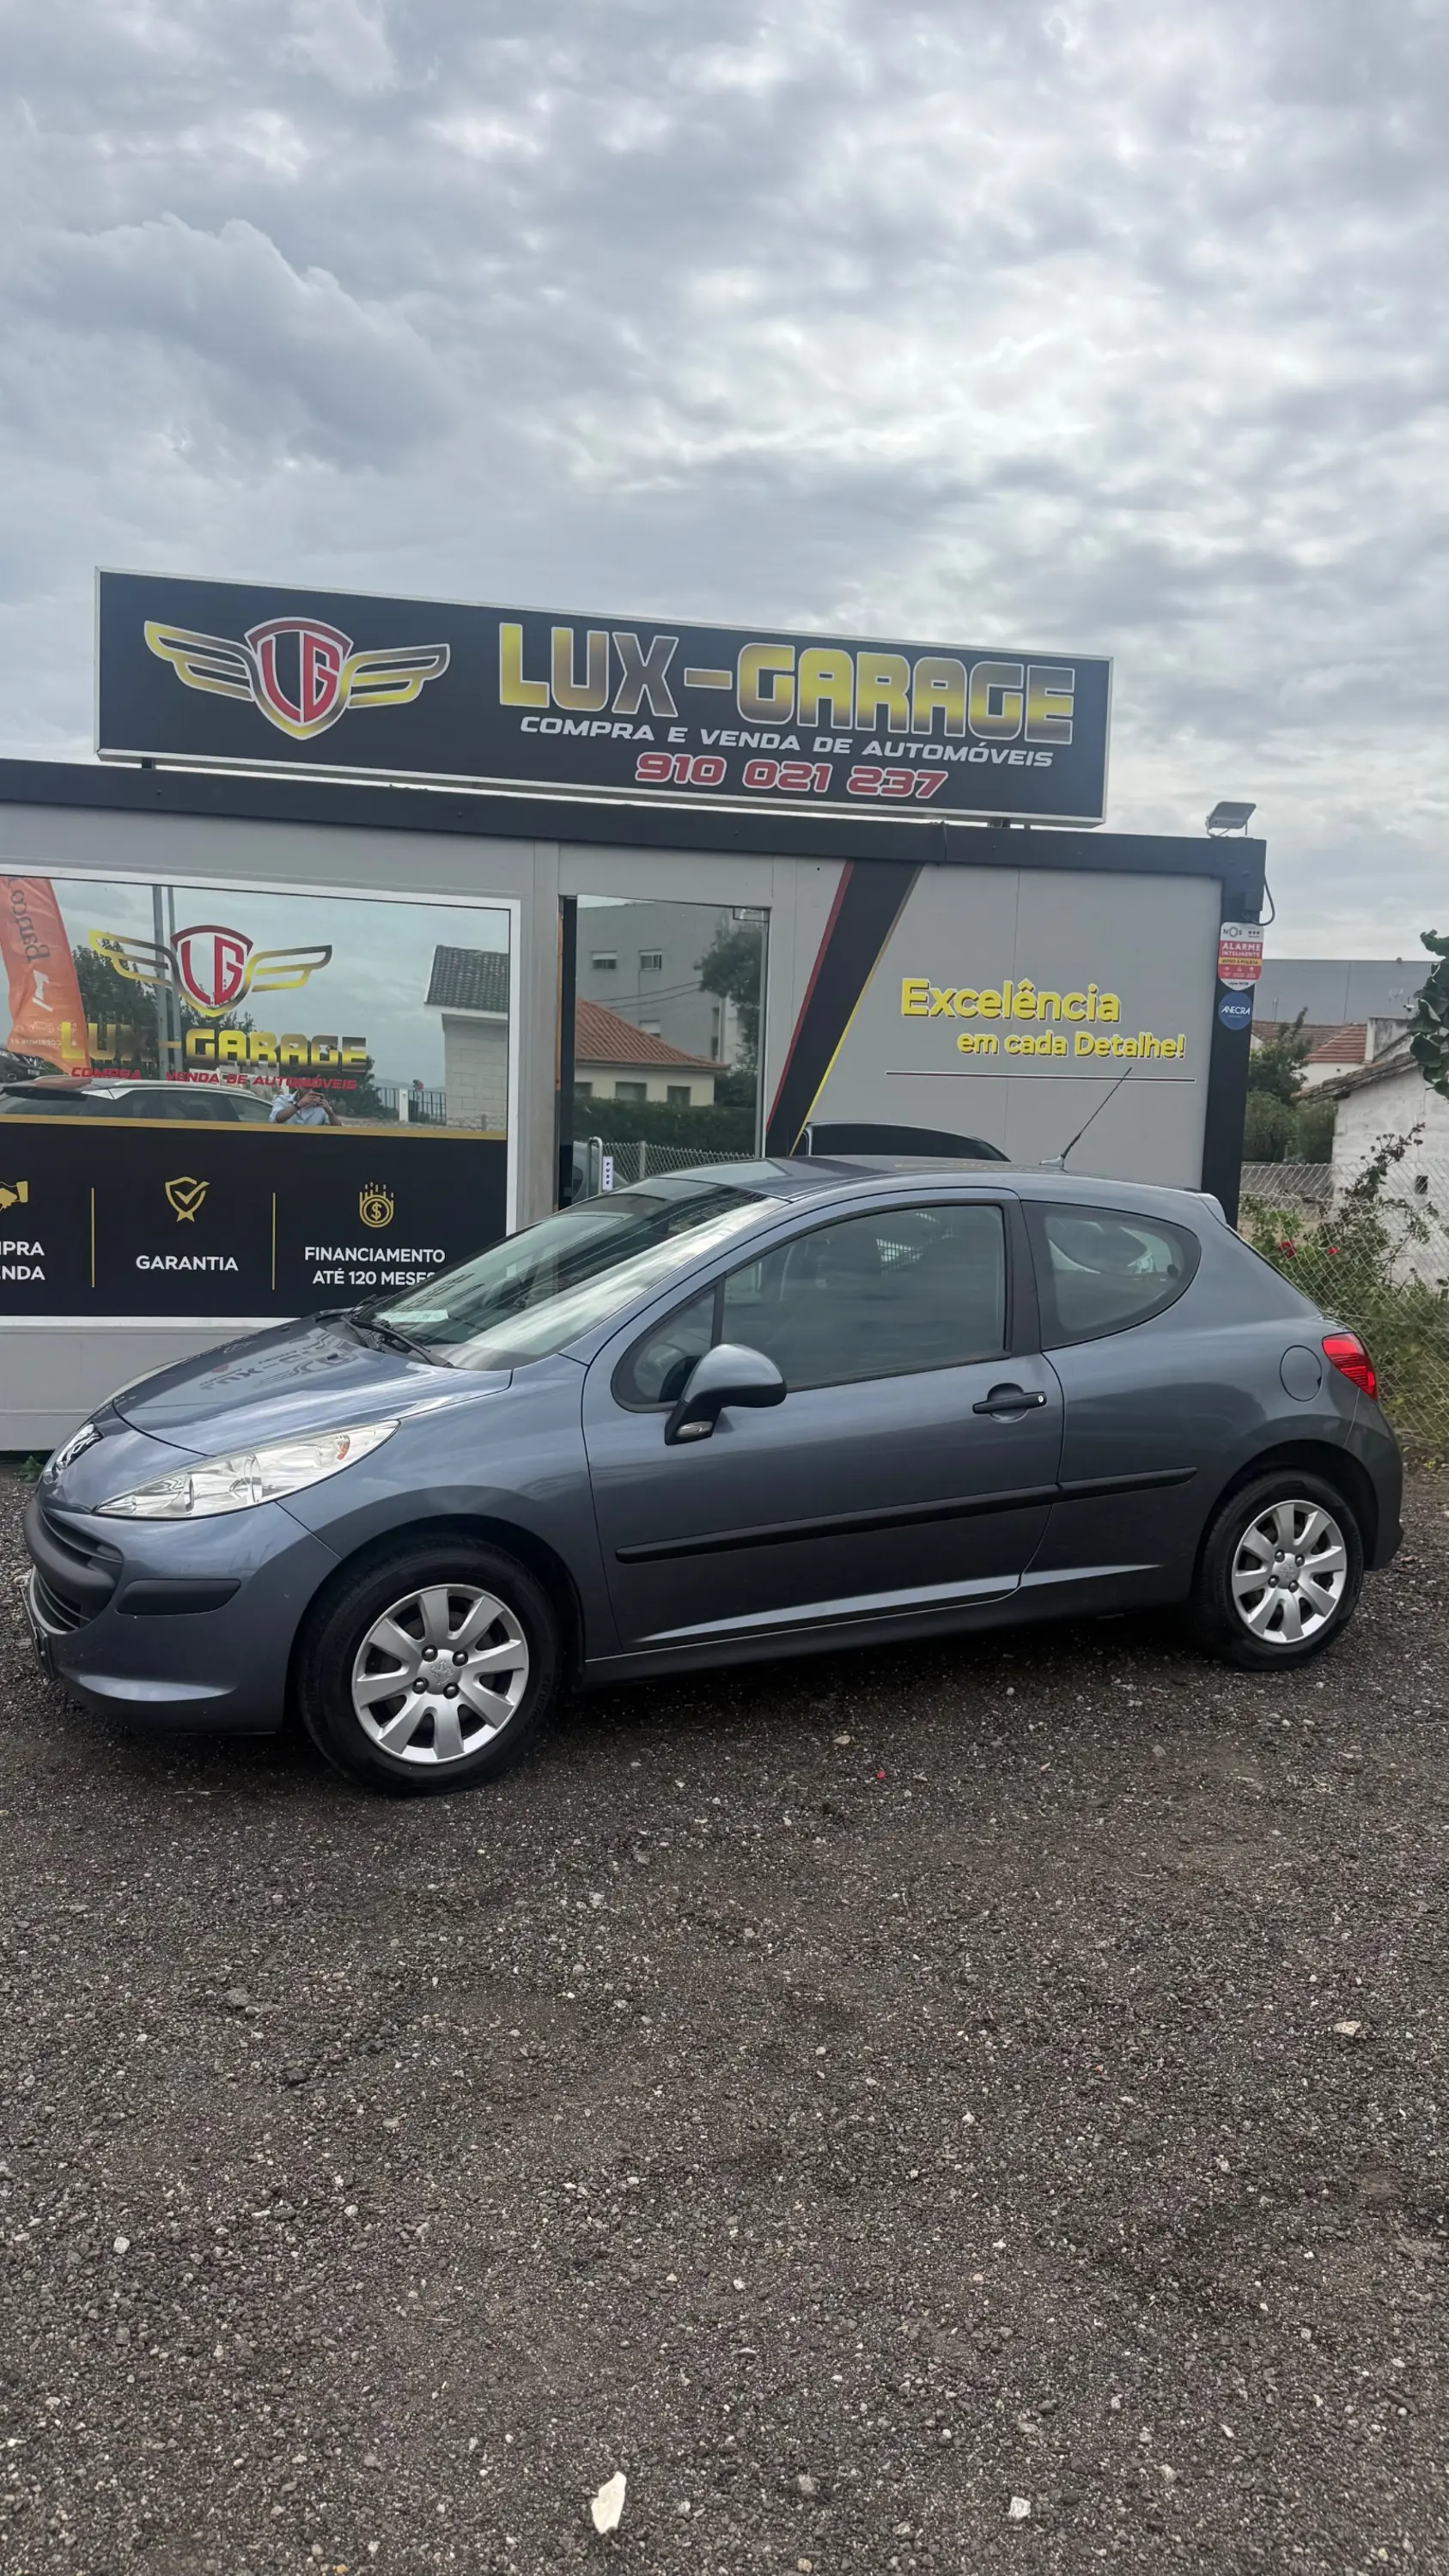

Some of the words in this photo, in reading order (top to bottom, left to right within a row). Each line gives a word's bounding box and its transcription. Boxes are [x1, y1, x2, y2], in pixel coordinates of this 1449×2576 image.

[498, 621, 1076, 745] LUX-GARAGE
[520, 715, 655, 742] COMPRA
[667, 727, 689, 744] E
[700, 728, 801, 751] VENDA
[812, 736, 854, 756] DE
[861, 741, 1054, 768] AUTOMÓVEIS
[635, 751, 728, 787] 910
[742, 759, 833, 793] 021
[846, 765, 949, 799] 237
[1222, 927, 1243, 938] NOS
[1221, 942, 1262, 951] ALARME
[900, 977, 1122, 1023] Excelência
[1221, 1005, 1251, 1015] ANECRA
[60, 1021, 367, 1073] LUX-GARAGE
[957, 1033, 999, 1055] em
[1004, 1030, 1068, 1057] cada
[1074, 1031, 1186, 1060] Detalhe!
[71, 1066, 143, 1080] COMPRA
[165, 1071, 220, 1084] VENDA
[226, 1074, 250, 1085] DE
[253, 1075, 357, 1091] AUTOMÓVEIS
[0, 1240, 46, 1256] PRA
[304, 1246, 446, 1264] FINANCIAMENTO
[0, 1265, 46, 1281] NDA
[136, 1255, 240, 1273] GARANTIA
[312, 1267, 345, 1285] ATÉ
[348, 1271, 377, 1285] 120
